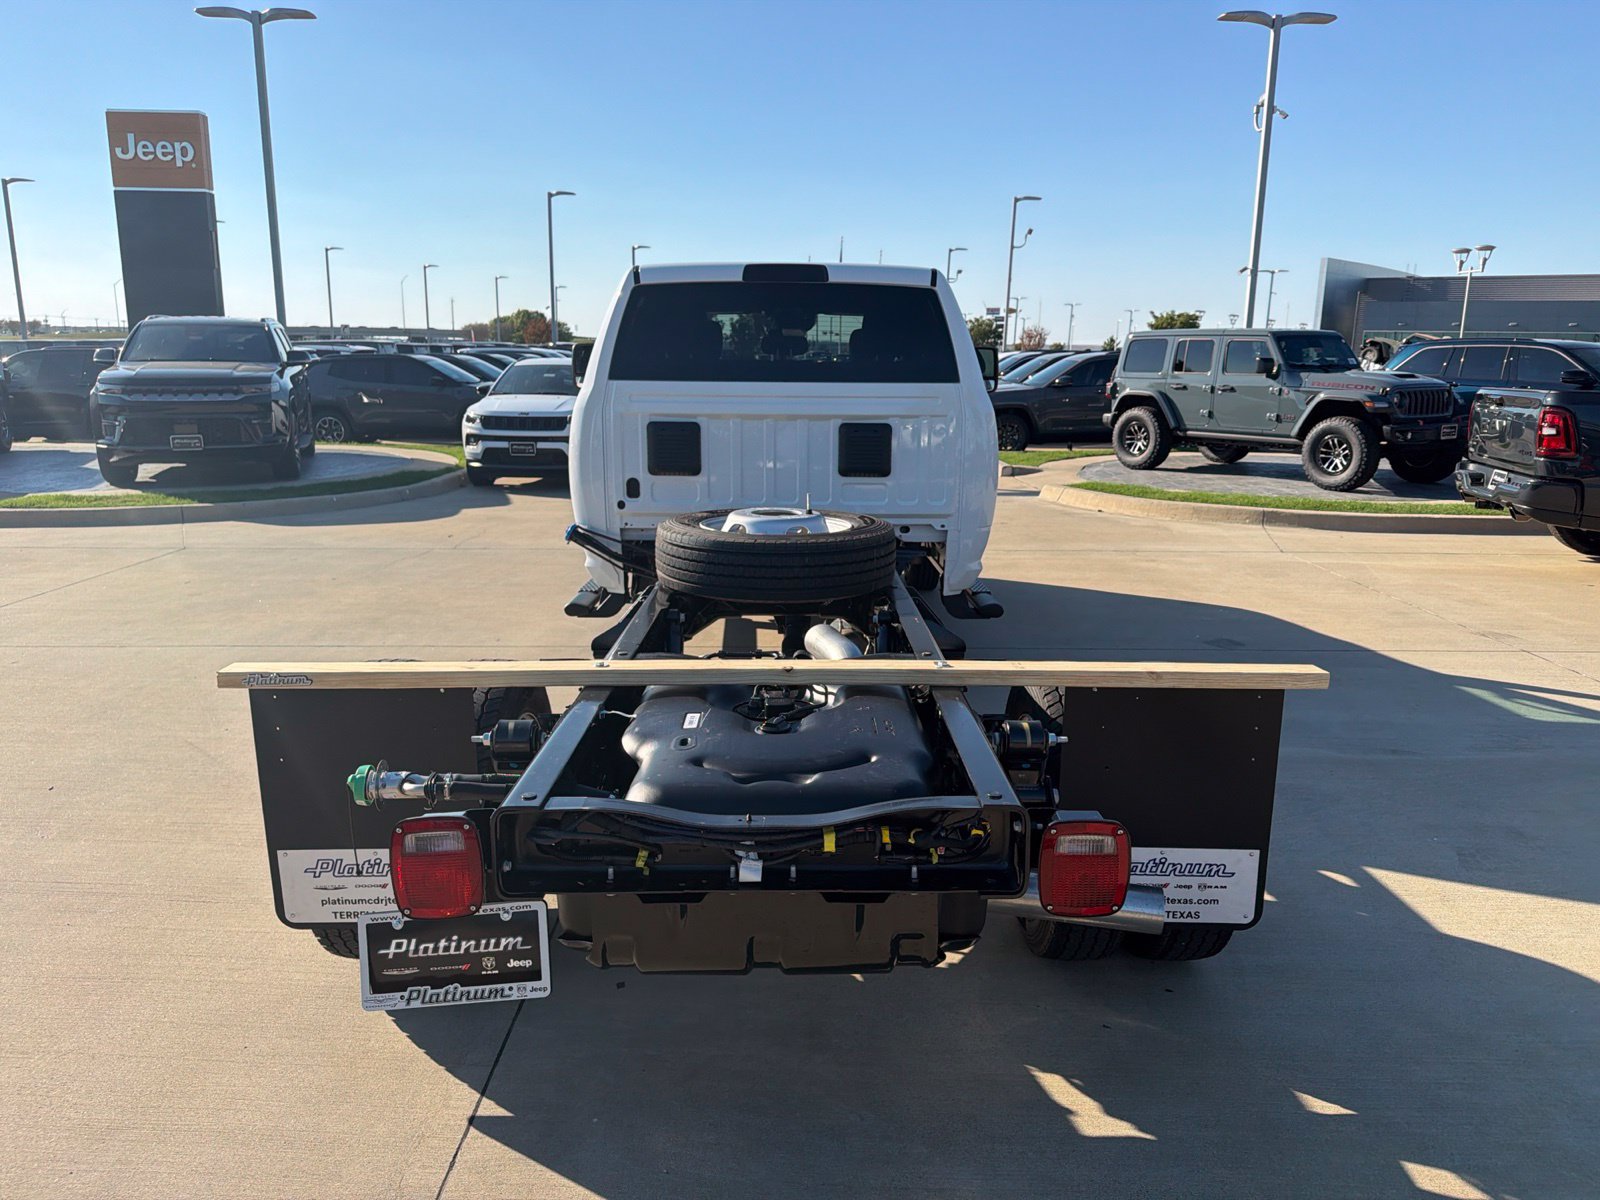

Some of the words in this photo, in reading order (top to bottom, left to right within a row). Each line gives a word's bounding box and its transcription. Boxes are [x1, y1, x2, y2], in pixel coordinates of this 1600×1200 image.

[114, 132, 196, 167] Jeep
[1311, 381, 1377, 391] RUBICON
[241, 672, 313, 687] Platinum
[1130, 857, 1236, 878] atinum
[321, 896, 397, 907] platinumcdrjte
[1165, 911, 1201, 919] TEXAS
[377, 935, 532, 959] Platinum
[507, 958, 533, 969] Jeep
[404, 984, 513, 1007] Platinum
[529, 985, 548, 993] Jeep
